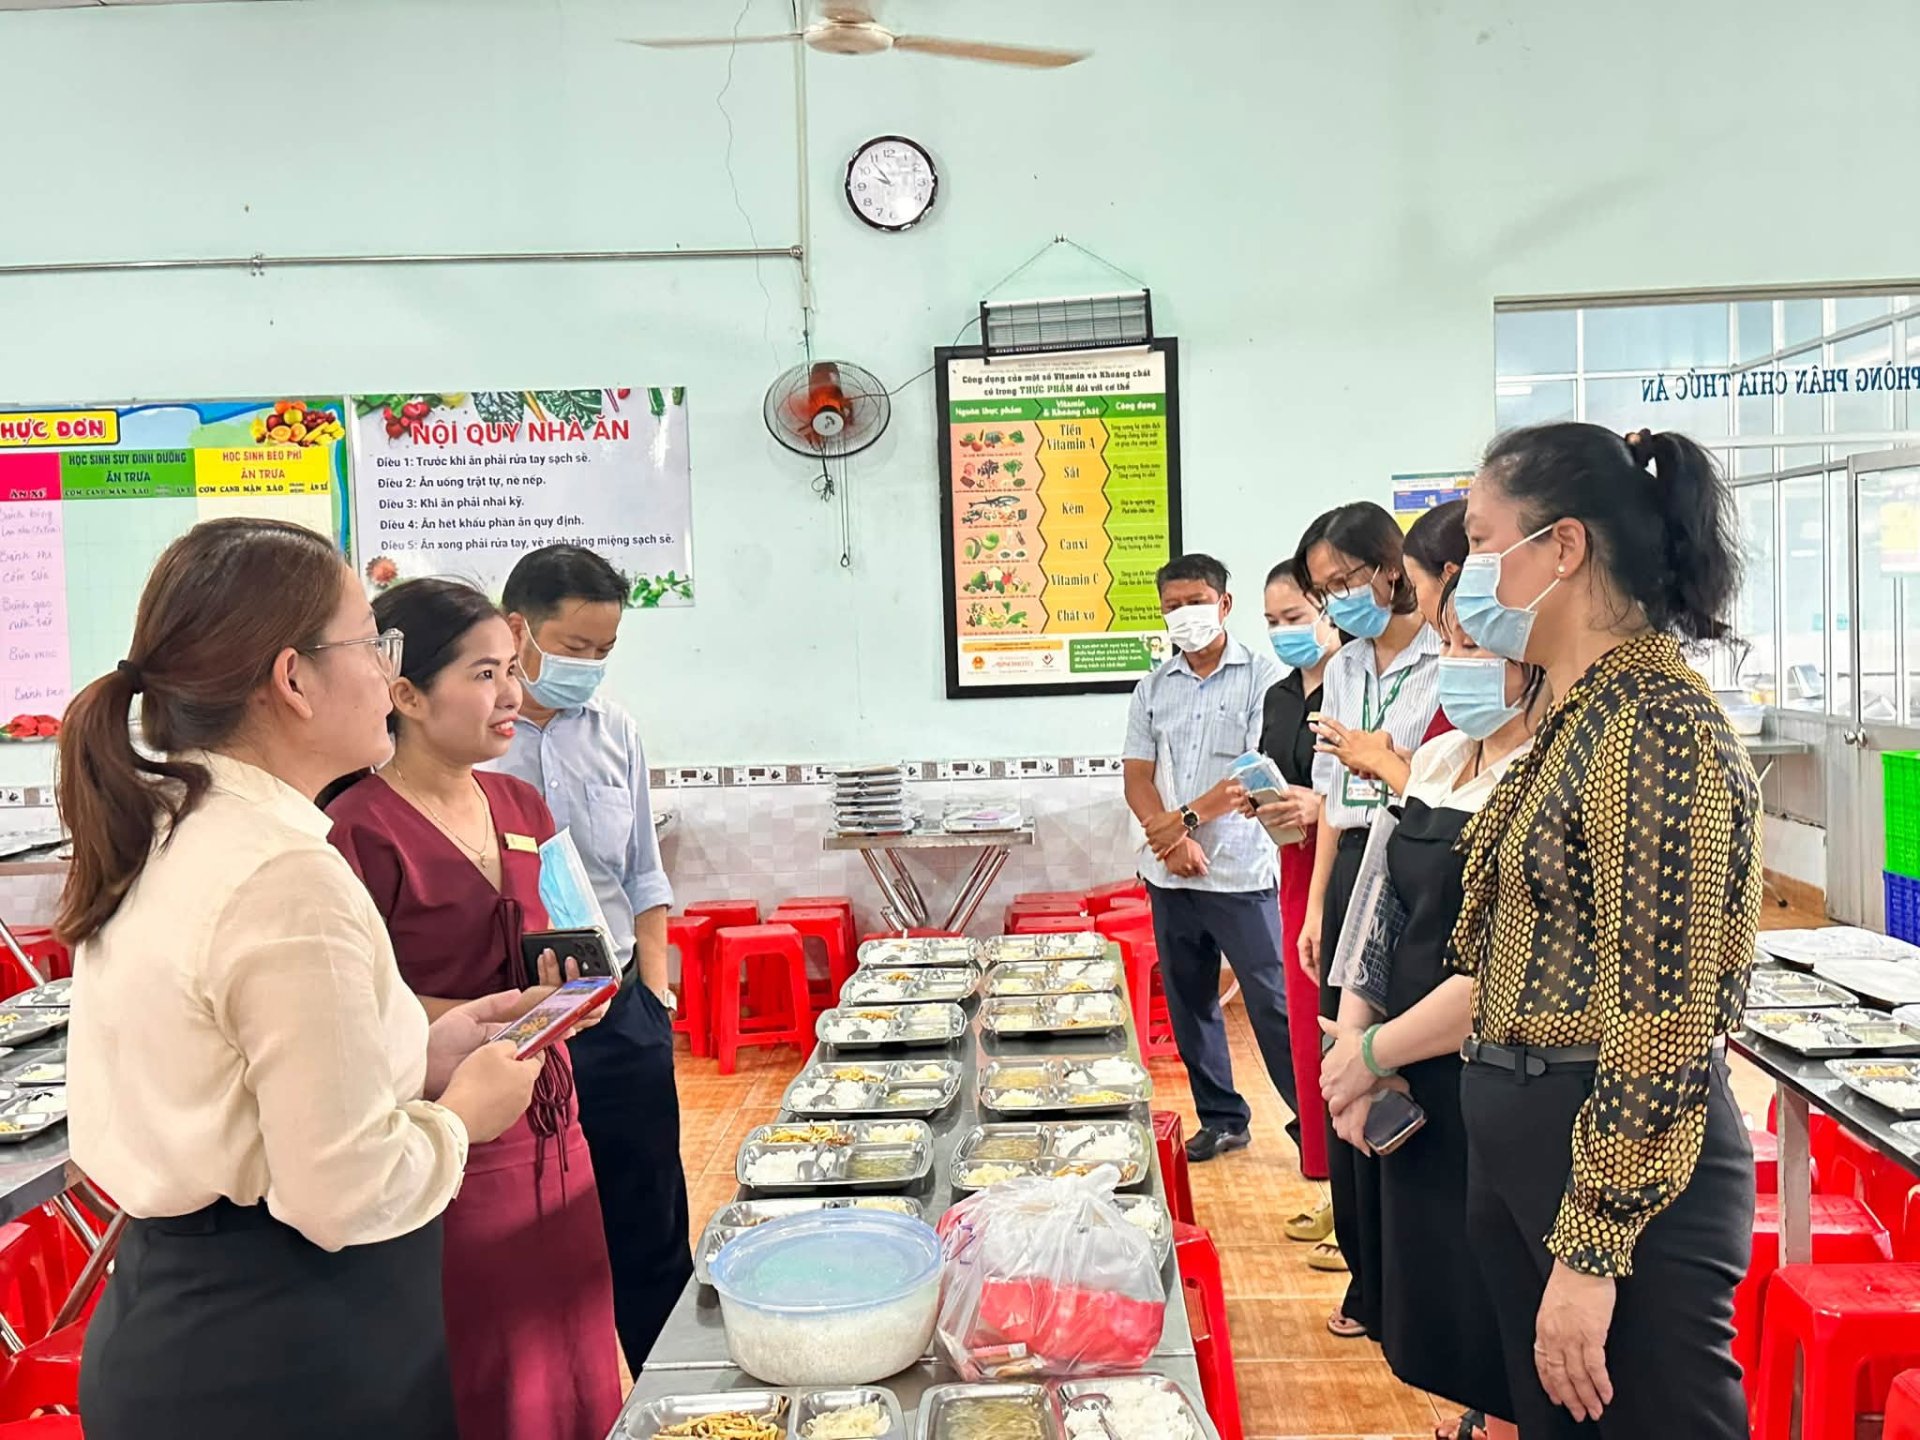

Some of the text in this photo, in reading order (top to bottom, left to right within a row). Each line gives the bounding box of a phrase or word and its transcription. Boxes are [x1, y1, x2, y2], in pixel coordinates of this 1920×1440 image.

[882, 149, 896, 158] 12
[857, 182, 867, 191] 9
[863, 197, 873, 206] 8
[875, 208, 883, 217] 7
[1054, 372, 1085, 380] Vitamin
[996, 388, 1017, 396] trong
[56, 418, 105, 438] ĐƠN
[412, 415, 629, 449] NỘI QUY NHÀ ĂN
[1046, 437, 1086, 451] Vitamin
[69, 454, 88, 466] HỌC
[90, 454, 111, 465] SINH
[113, 454, 130, 464] SUY
[222, 452, 240, 462] HỌC
[243, 450, 264, 461] SINH
[376, 457, 401, 467] Điều
[404, 457, 414, 466] 1:
[416, 456, 448, 466] Trước
[450, 455, 466, 466] khi
[469, 454, 481, 465] ăn
[485, 453, 506, 467] phải
[509, 453, 527, 465] rửa
[530, 454, 545, 466] tay
[549, 453, 573, 465] sạch
[106, 470, 151, 482] ĂN TRƯA
[241, 468, 285, 479] ĂN TRƯA
[1064, 465, 1080, 478] Sắt
[378, 477, 403, 488] Điều
[405, 477, 416, 488] 2:
[419, 475, 434, 487] Ăn
[436, 475, 464, 488] uống
[467, 476, 486, 488] trật
[489, 476, 504, 488] tự,
[523, 474, 546, 487] nếp.
[379, 495, 524, 509] Điều 3: Khi ăn phải nhai kỹ.
[1062, 501, 1084, 515] Kẽm
[380, 515, 584, 530] Điều 4: Ăn hết khẩu phần ăn quy định.
[381, 539, 405, 550] Điều
[407, 540, 418, 550] 5:
[420, 538, 435, 550] Ăn
[437, 540, 463, 551] xong
[465, 538, 488, 550] phải
[490, 537, 508, 549] rửa
[511, 538, 529, 550] tay,
[597, 534, 630, 548] miệng
[632, 534, 657, 546] sạch
[1060, 538, 1088, 550] Canxi
[1051, 573, 1091, 586] Vitamin
[1057, 609, 1080, 621] Chất
